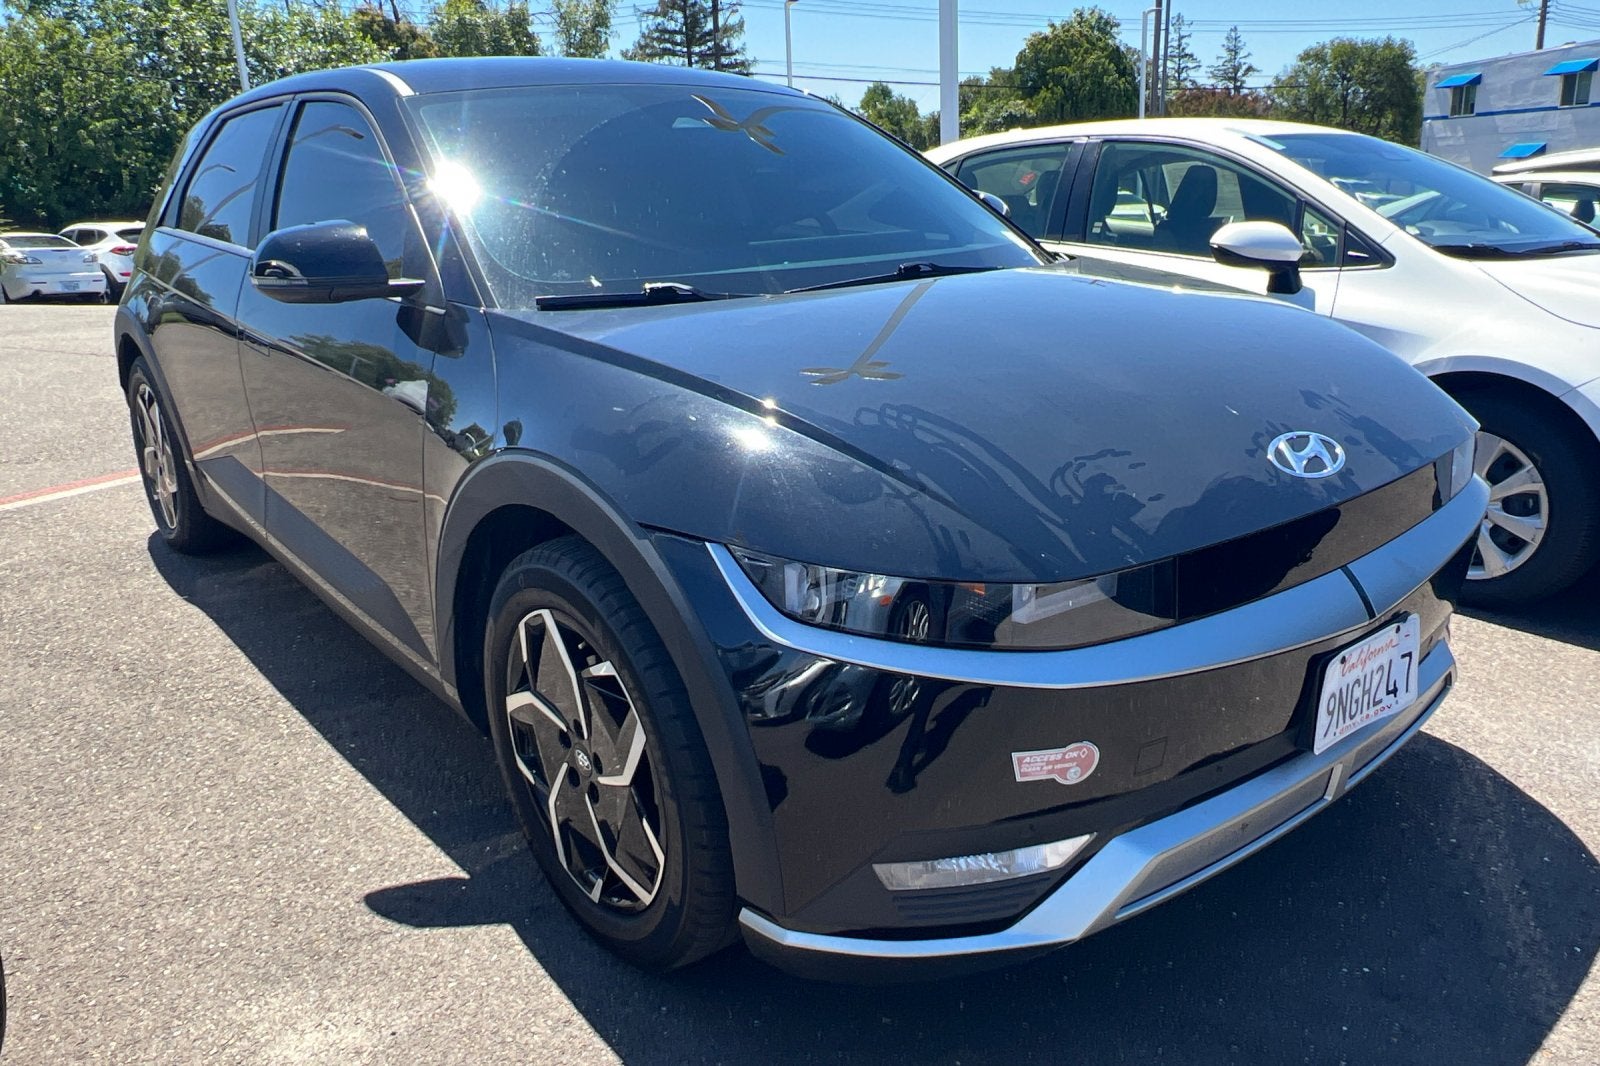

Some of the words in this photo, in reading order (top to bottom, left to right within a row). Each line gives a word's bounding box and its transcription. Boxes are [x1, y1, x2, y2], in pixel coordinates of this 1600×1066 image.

[1341, 638, 1400, 677] California
[1324, 651, 1413, 738] 9NGH247
[1023, 753, 1062, 763] ACCESS
[1065, 750, 1080, 759] OK
